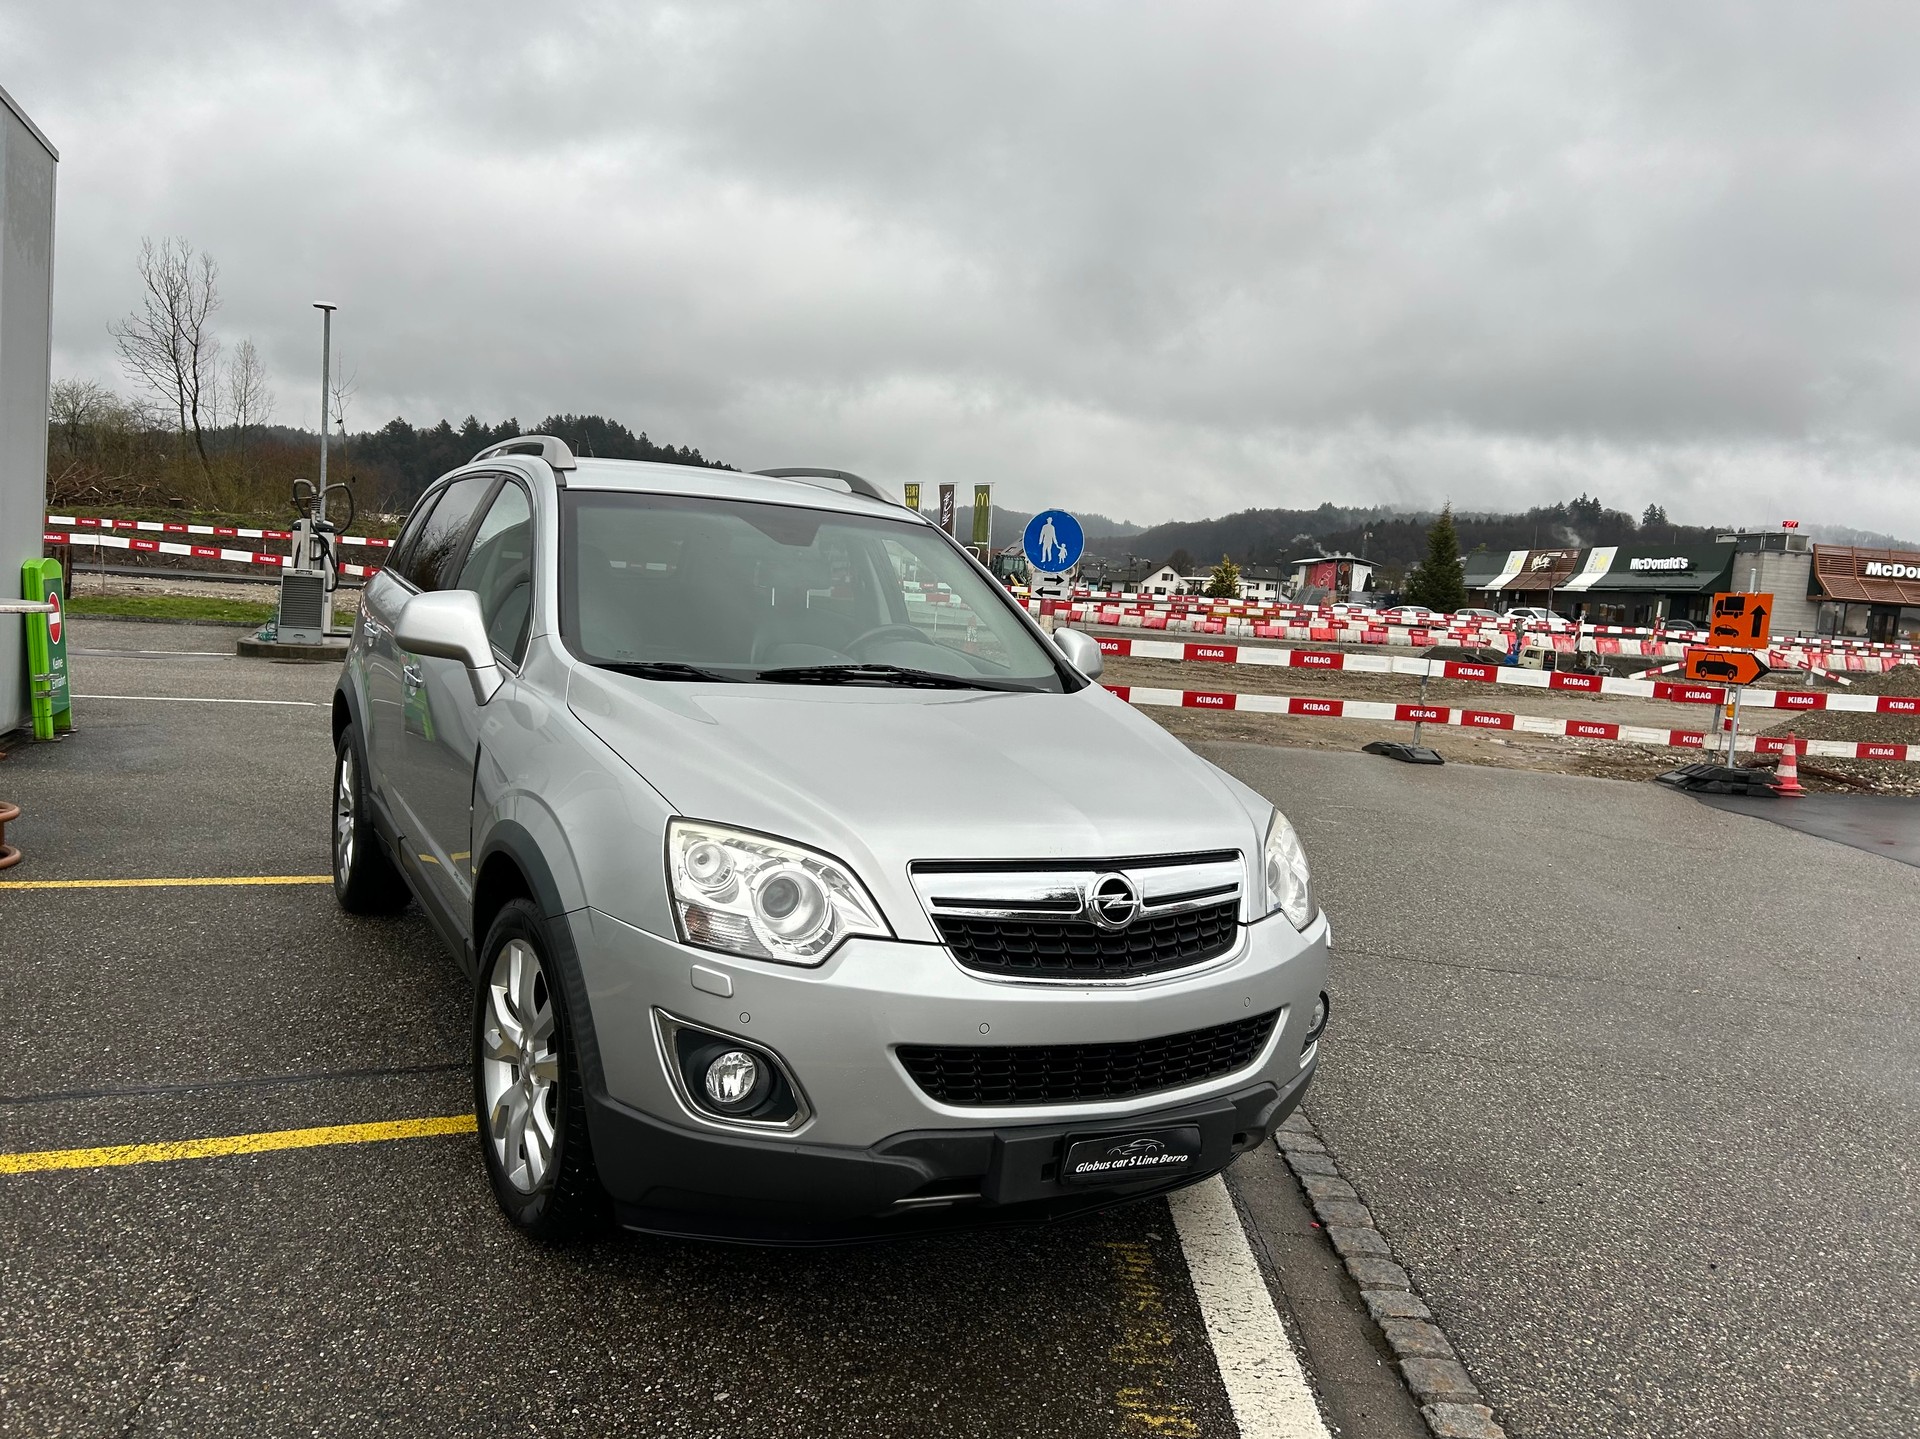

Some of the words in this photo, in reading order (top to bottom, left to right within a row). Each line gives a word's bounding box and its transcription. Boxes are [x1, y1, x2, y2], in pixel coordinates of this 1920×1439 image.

[1630, 557, 1689, 570] McDonald's
[1101, 642, 1118, 650] BAG
[1196, 648, 1225, 658] KIBAG
[1303, 655, 1331, 665] KIBAG
[1458, 667, 1485, 677] KIBAG
[1563, 677, 1590, 687] KIBAG
[1685, 691, 1712, 700] KIBAG
[1196, 696, 1224, 705] KIBAG
[1787, 696, 1814, 705] KIBAG
[1303, 703, 1331, 712] KIBAG
[1889, 701, 1915, 710] KIBAG
[1474, 715, 1501, 725] KIBAG
[1578, 725, 1605, 735] KIBAG
[1682, 735, 1703, 744] KIBA
[1767, 742, 1785, 750] KIB
[1868, 747, 1895, 756] KIBAG
[1075, 1161, 1111, 1173] Globus
[1112, 1159, 1127, 1169] car
[1129, 1156, 1137, 1167] S
[1137, 1154, 1159, 1166] Line
[1159, 1154, 1188, 1164] Berro
